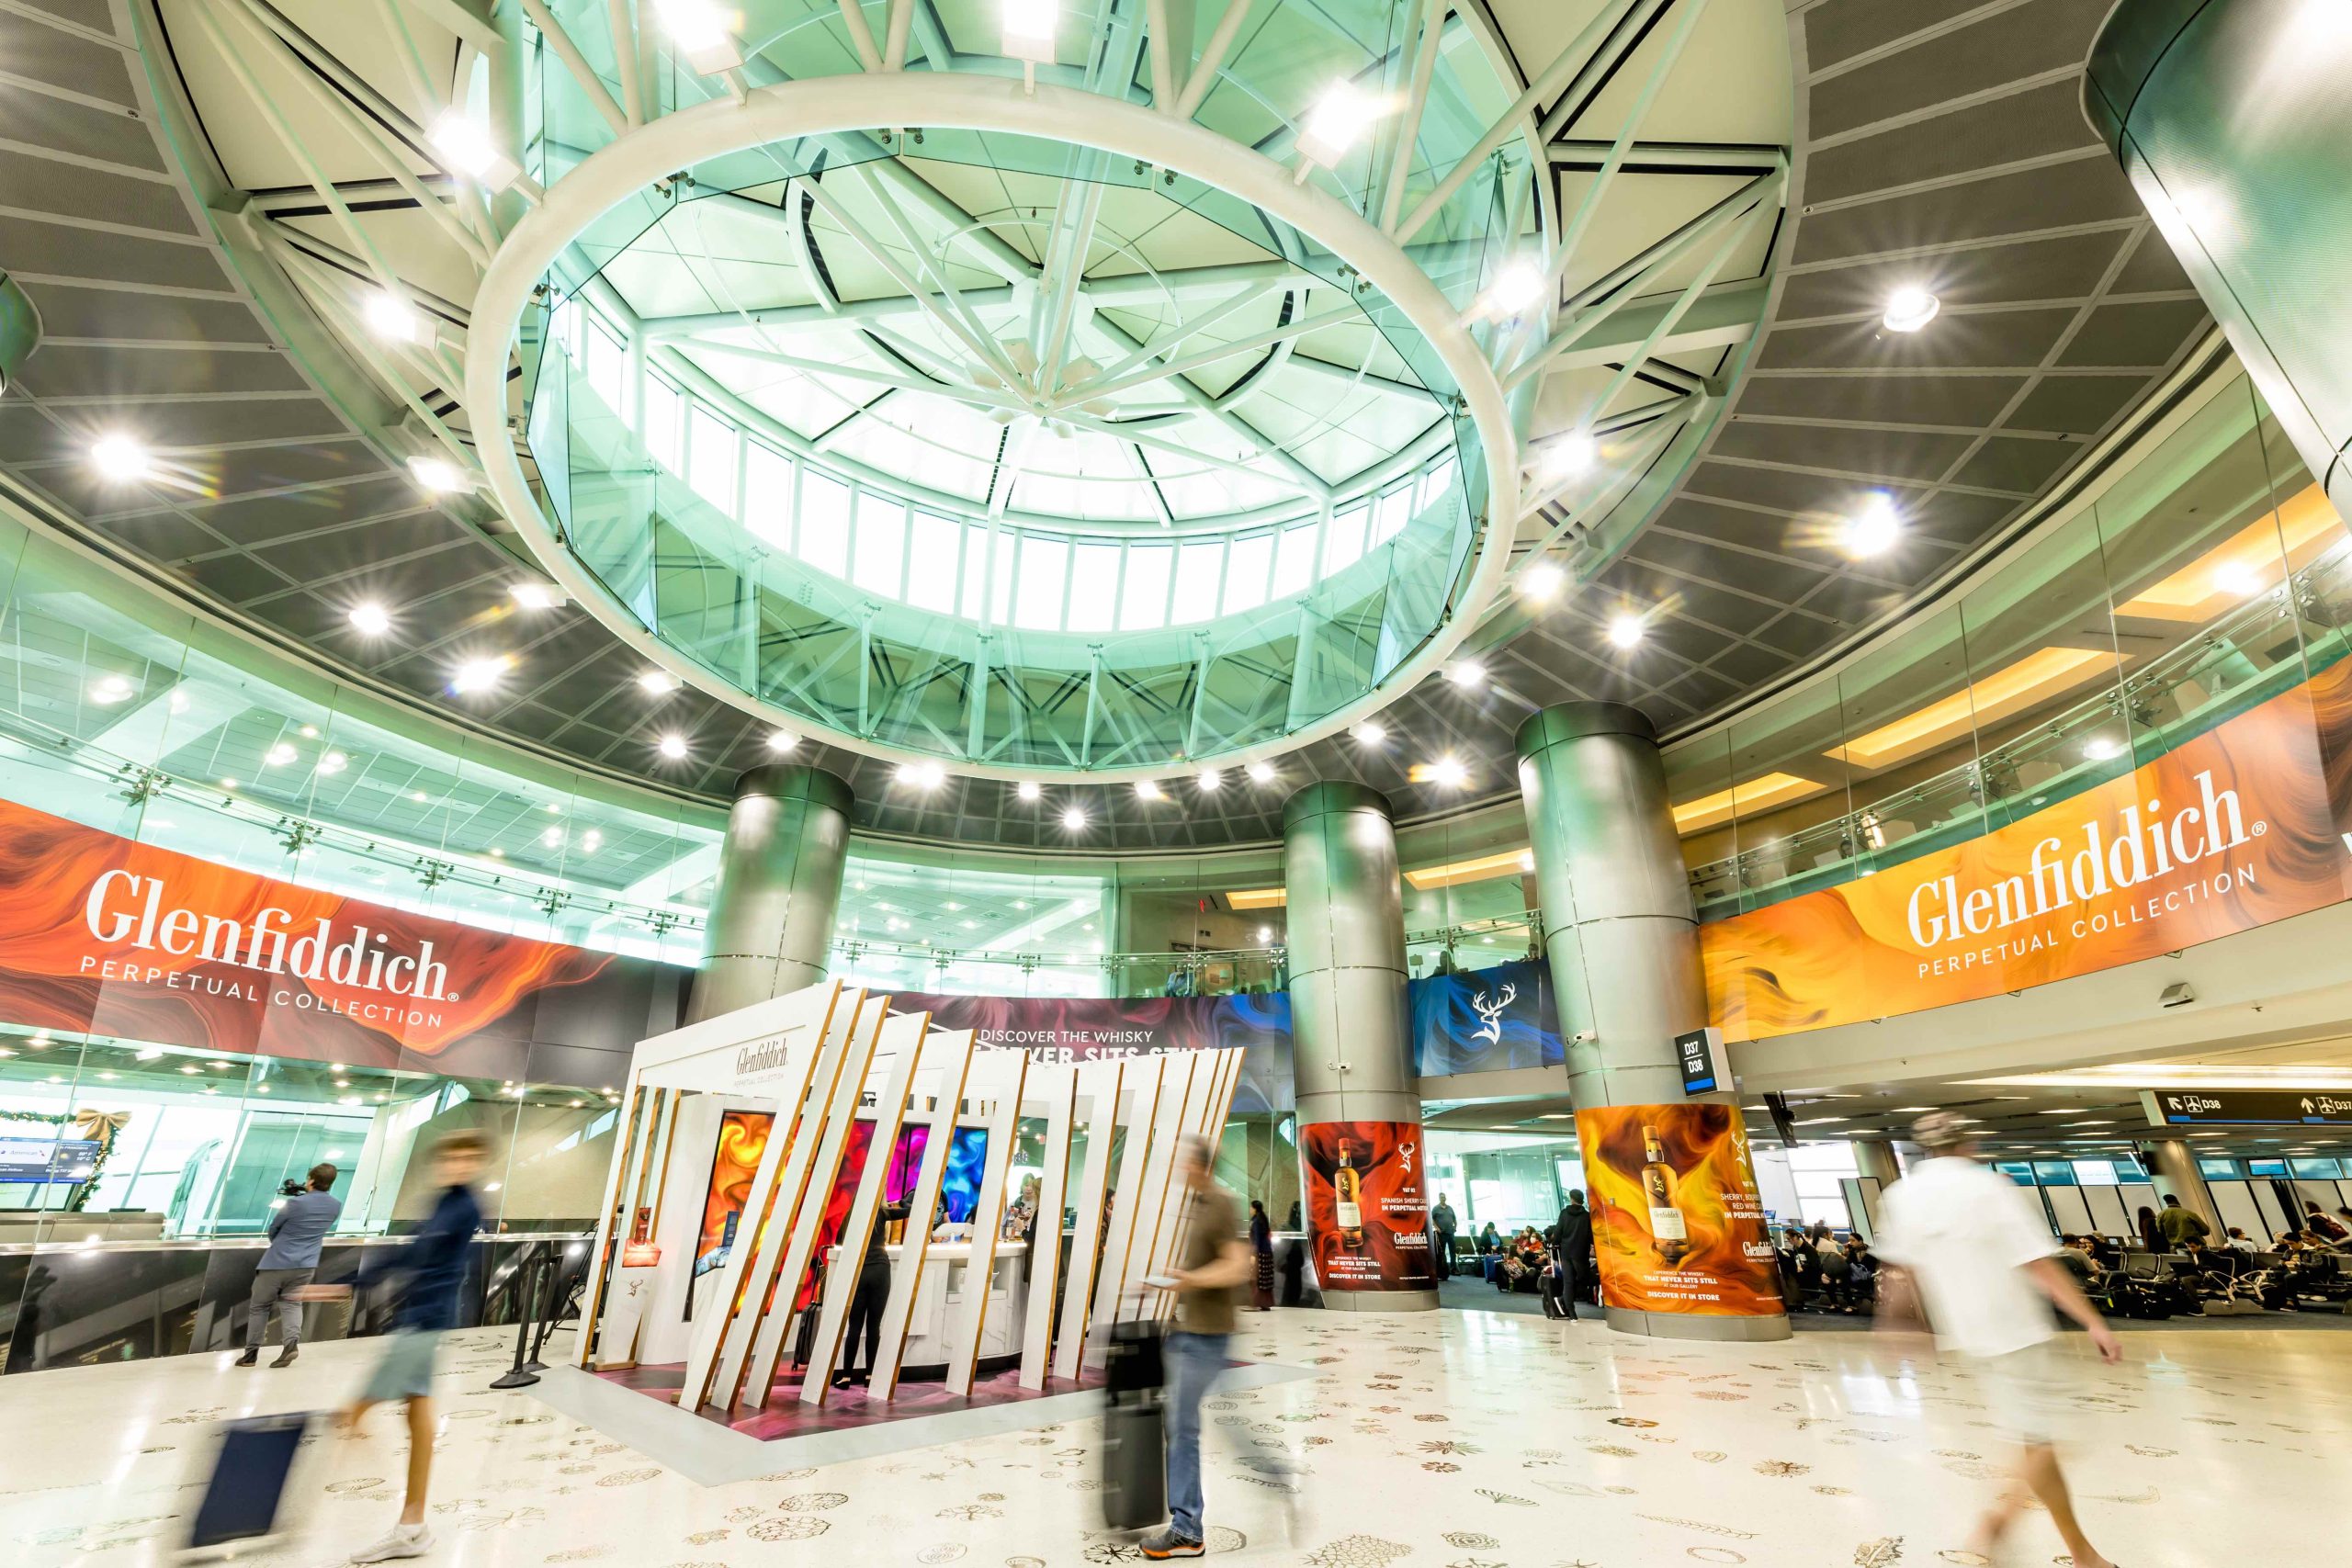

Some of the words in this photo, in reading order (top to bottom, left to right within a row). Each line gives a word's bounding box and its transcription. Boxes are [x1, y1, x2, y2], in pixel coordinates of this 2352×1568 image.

[1918, 930, 2059, 979] PERPETUAL
[2072, 863, 2256, 938] COLLECTION
[80, 955, 257, 1001] PERPETUAL
[275, 990, 441, 1028] COLLECTION
[980, 1029, 1056, 1043] DISCOVER
[1060, 1031, 1089, 1043] THE
[1093, 1031, 1153, 1043] WHISKY
[1684, 1041, 1699, 1055] D37
[736, 1037, 787, 1075] Glenfiddich
[1688, 1059, 1704, 1073] D38
[2202, 1100, 2222, 1110] D38
[2334, 1100, 2352, 1111] D37
[1720, 1193, 1745, 1201] SHERRY,
[1394, 1232, 1428, 1245] Glenfiddich
